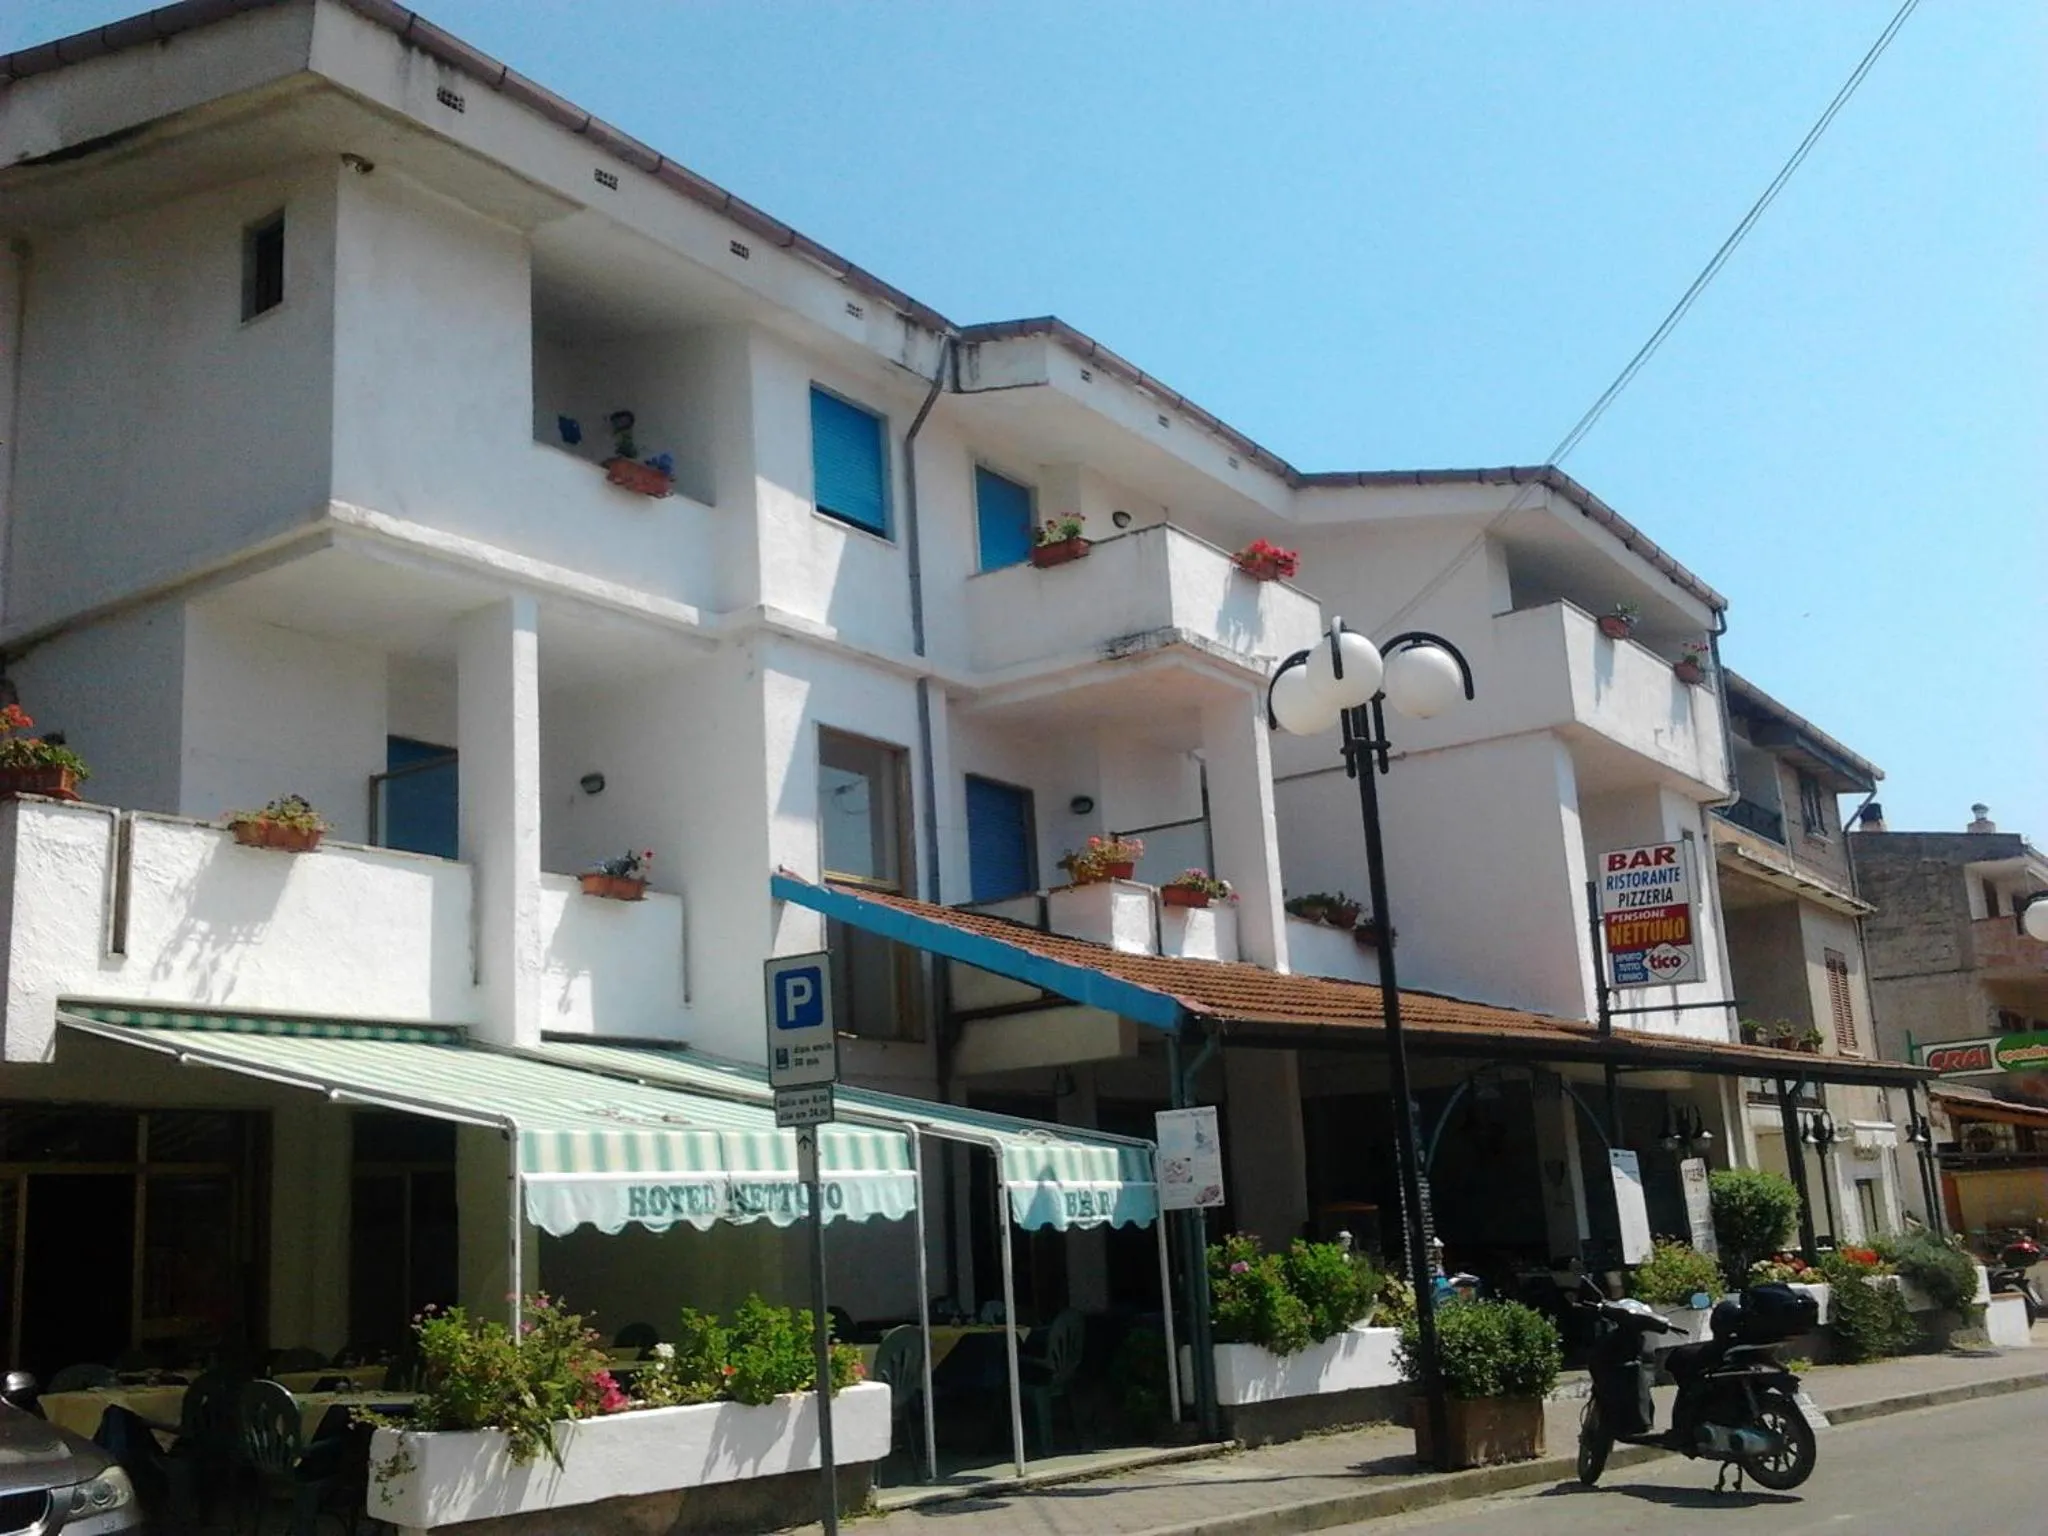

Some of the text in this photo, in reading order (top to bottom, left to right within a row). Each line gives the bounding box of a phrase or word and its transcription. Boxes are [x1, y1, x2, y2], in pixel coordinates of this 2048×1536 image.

[1608, 846, 1676, 872] BAR
[1606, 867, 1680, 891] RISTORANTE
[1618, 887, 1674, 908] PIZZERIA
[1611, 909, 1666, 922] PENSIONE
[1611, 916, 1686, 946] NETTUNO
[1649, 954, 1682, 970] tico
[786, 976, 812, 1022] P
[1929, 1046, 1989, 1070] CRAI
[628, 1184, 717, 1217] HOTEL
[727, 1181, 843, 1214] NETTUO
